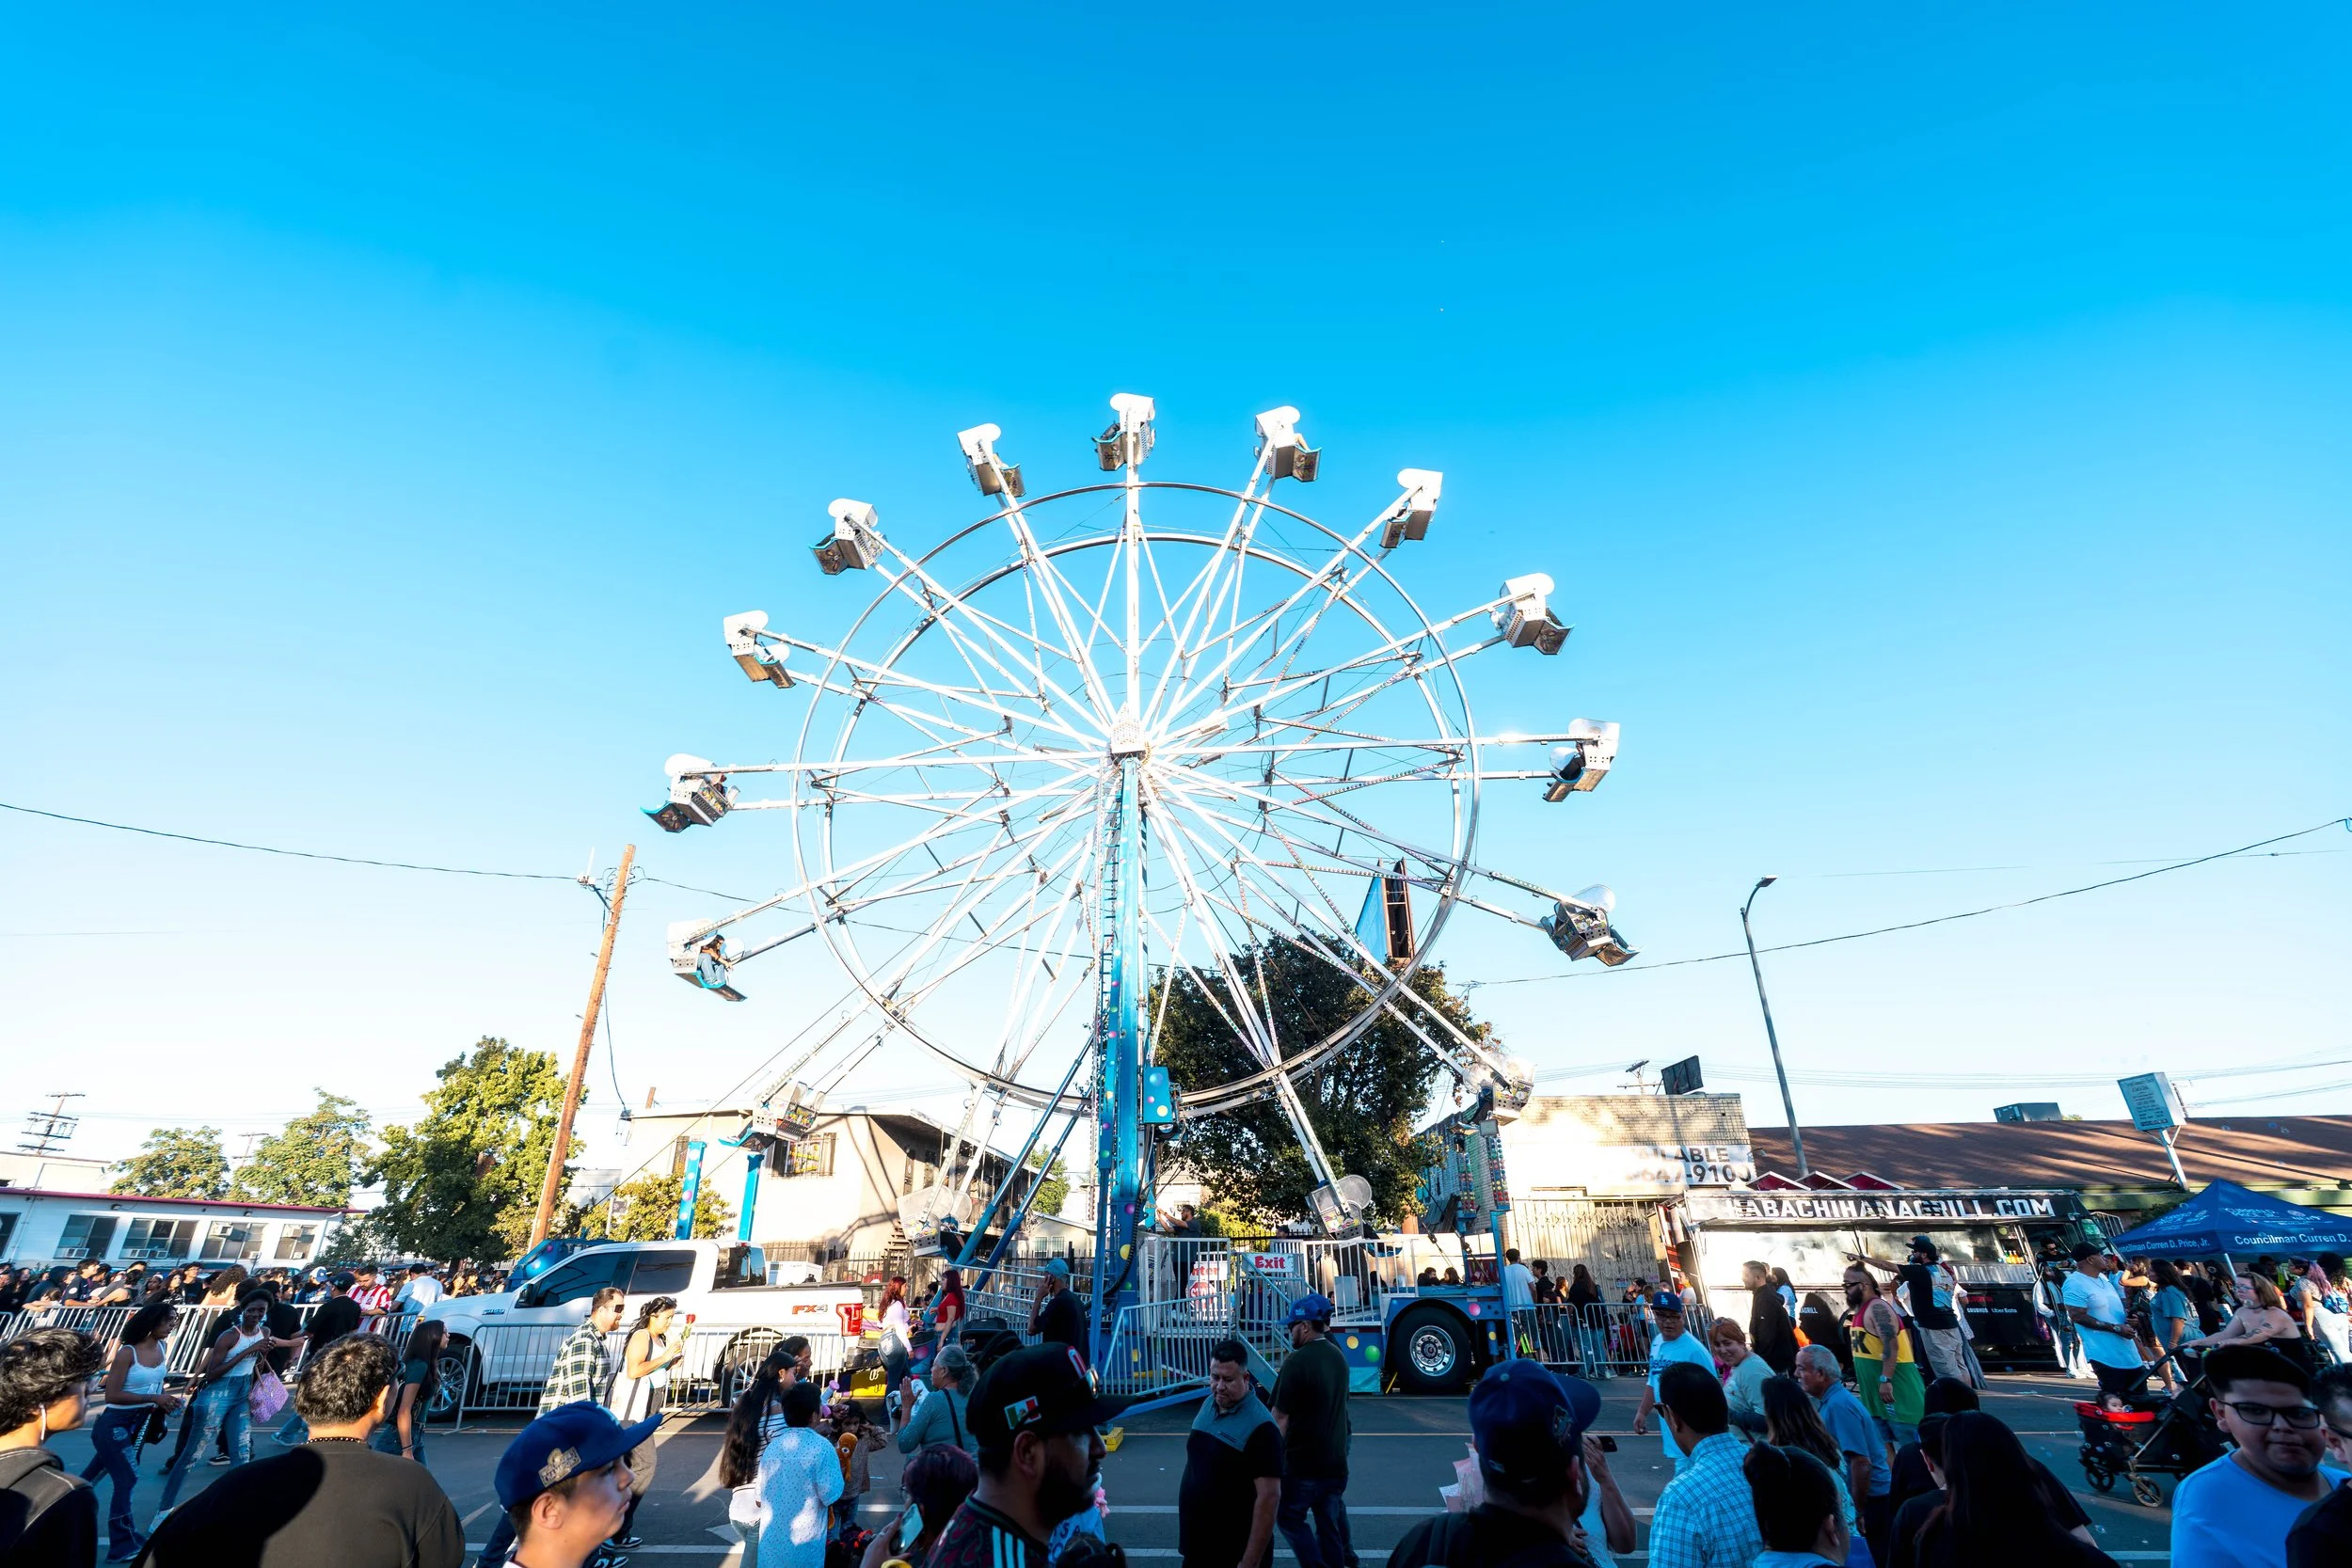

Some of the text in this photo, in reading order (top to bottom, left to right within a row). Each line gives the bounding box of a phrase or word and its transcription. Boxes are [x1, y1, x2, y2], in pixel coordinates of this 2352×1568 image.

[2234, 1234, 2297, 1245] Councilman
[2298, 1233, 2337, 1243] Curren
[2146, 1241, 2169, 1250] Curren
[1254, 1256, 1286, 1270] Exit
[1191, 1266, 1220, 1275] nter
[792, 1305, 829, 1315] FX4
